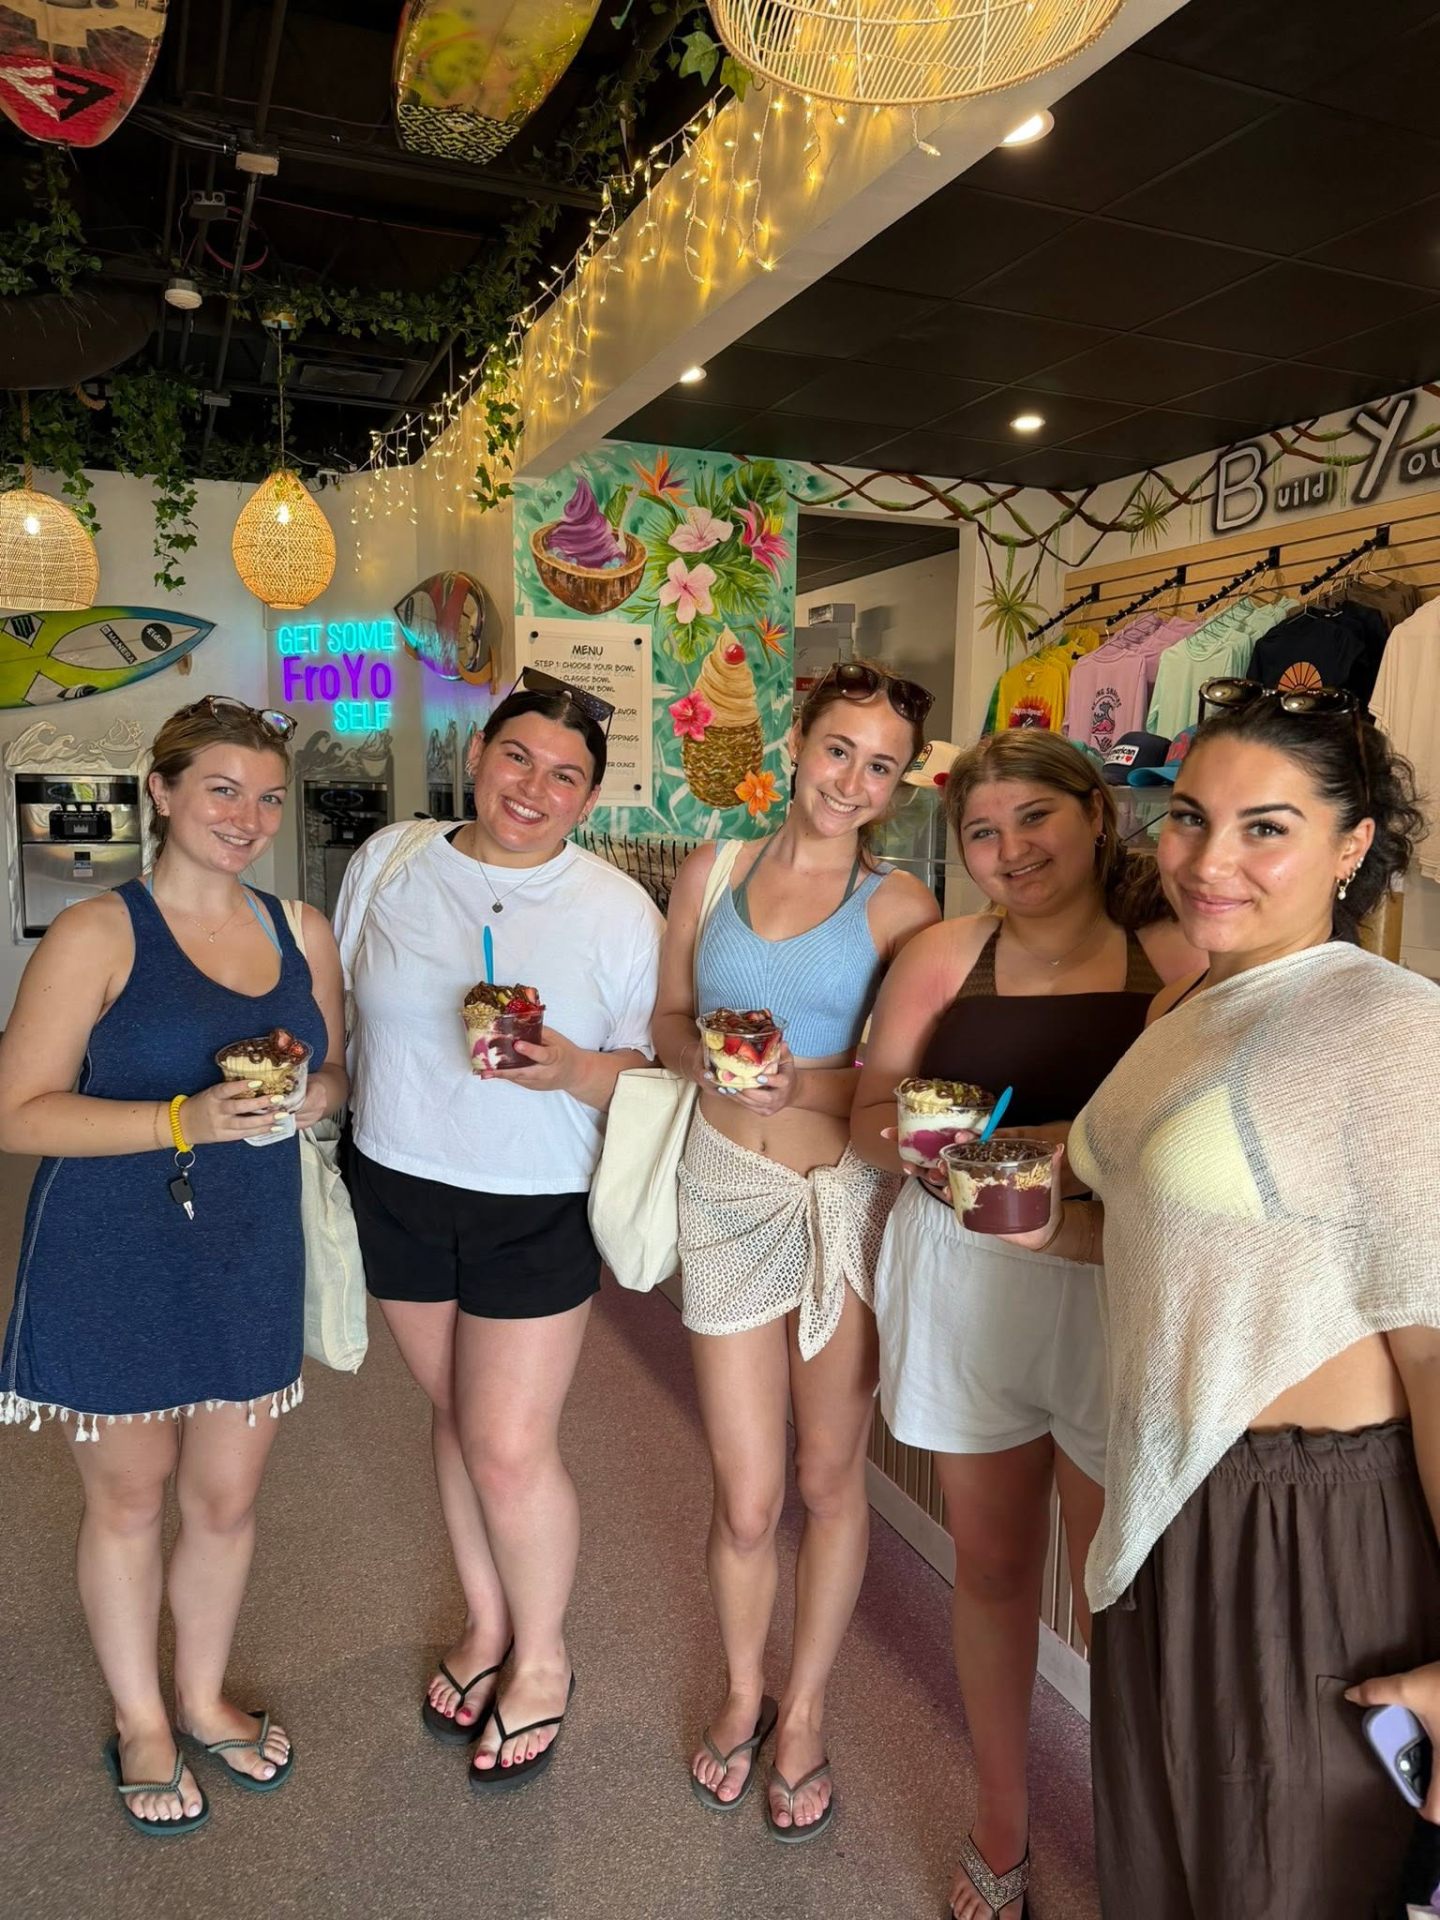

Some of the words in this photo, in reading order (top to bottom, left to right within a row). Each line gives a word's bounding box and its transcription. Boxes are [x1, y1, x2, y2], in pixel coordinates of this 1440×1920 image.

[1215, 446, 1325, 531] Build
[277, 623, 323, 655] GET
[327, 620, 397, 652] SOME
[107, 632, 136, 664] MANERA
[571, 645, 604, 656] MENU
[534, 660, 554, 668] STEP
[562, 661, 592, 670] CHOOSE
[593, 663, 613, 672] YOUR
[615, 664, 636, 672] BOWL
[283, 653, 393, 702] FroYo
[592, 675, 611, 684] BOWL
[597, 685, 615, 693] BOWL
[333, 701, 392, 731] SELF
[613, 708, 637, 716] LAVOR
[608, 734, 640, 742] OPPINGS
